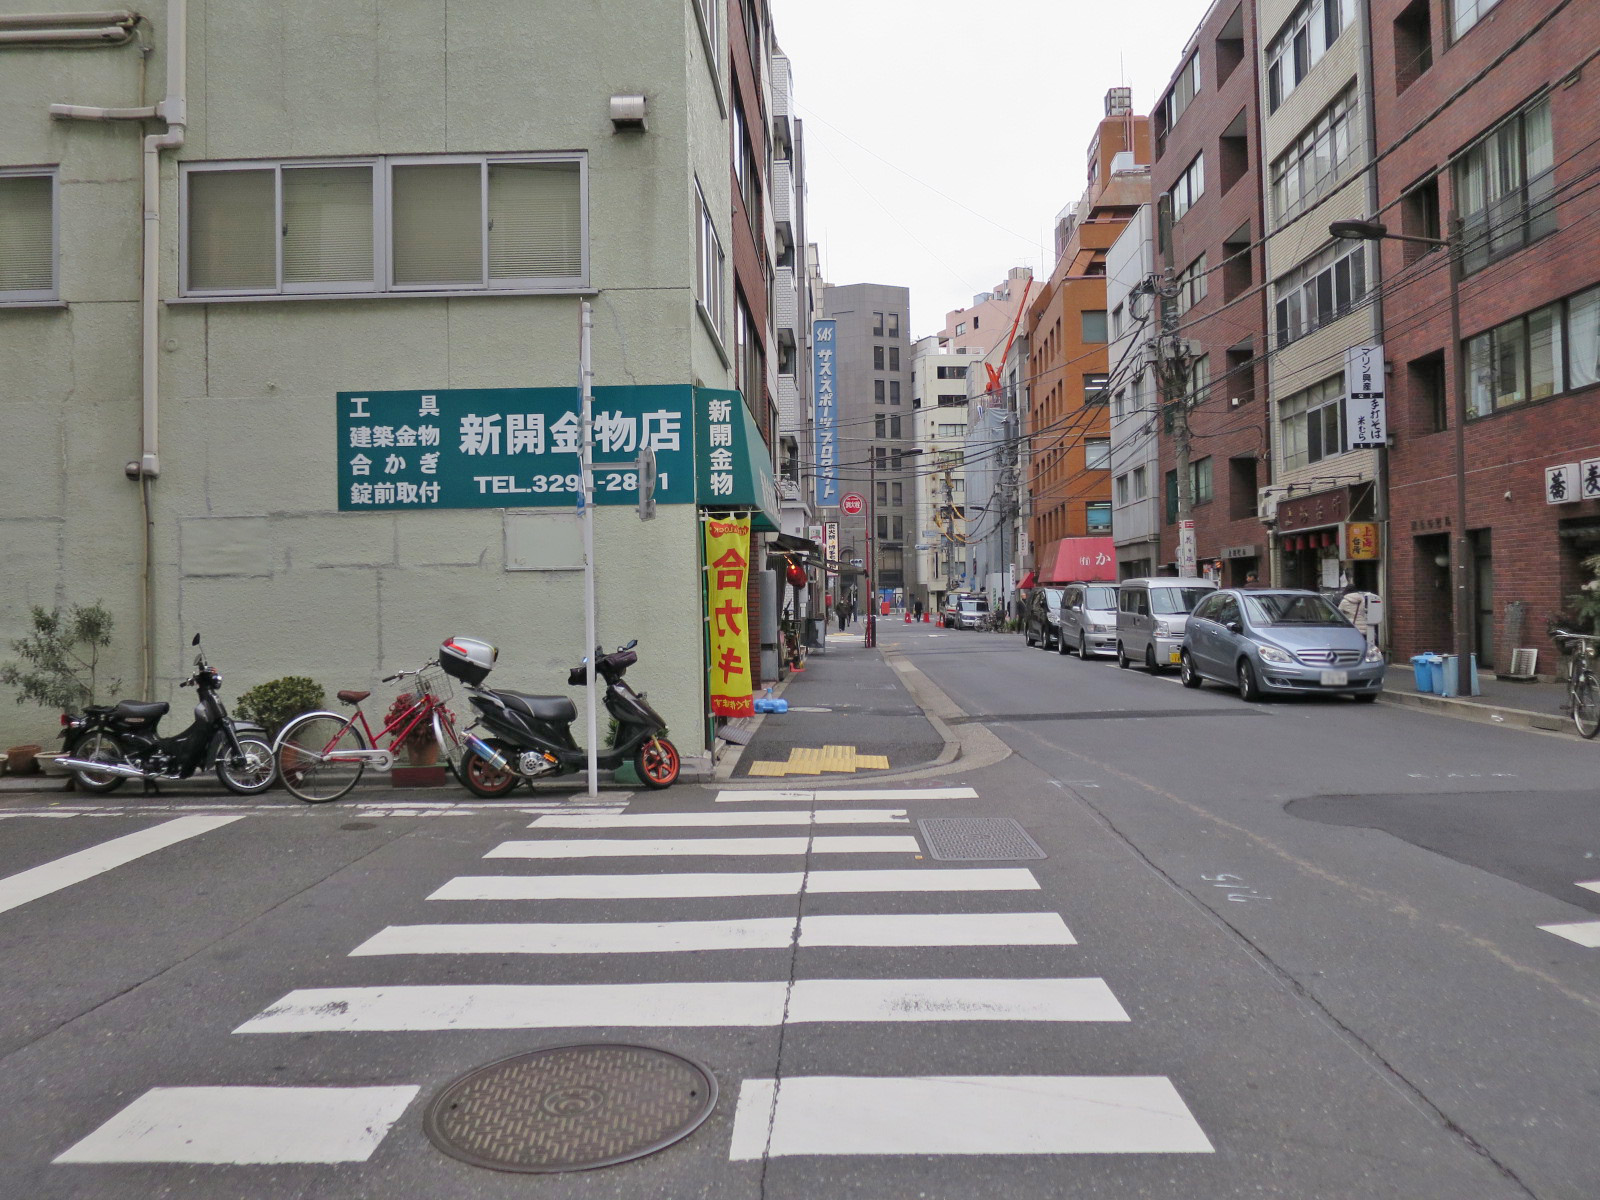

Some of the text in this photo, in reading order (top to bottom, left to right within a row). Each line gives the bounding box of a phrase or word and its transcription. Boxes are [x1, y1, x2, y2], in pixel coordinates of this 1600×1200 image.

[816, 327, 834, 341] SAS
[1361, 347, 1372, 391] マリン興産
[459, 409, 682, 456] 新開金物店
[1370, 399, 1381, 439] 手打そば
[350, 425, 440, 447] 建築金物
[708, 399, 734, 496] 新開金物
[350, 481, 441, 504] 錠前取付
[473, 472, 669, 494] TEL.329-281
